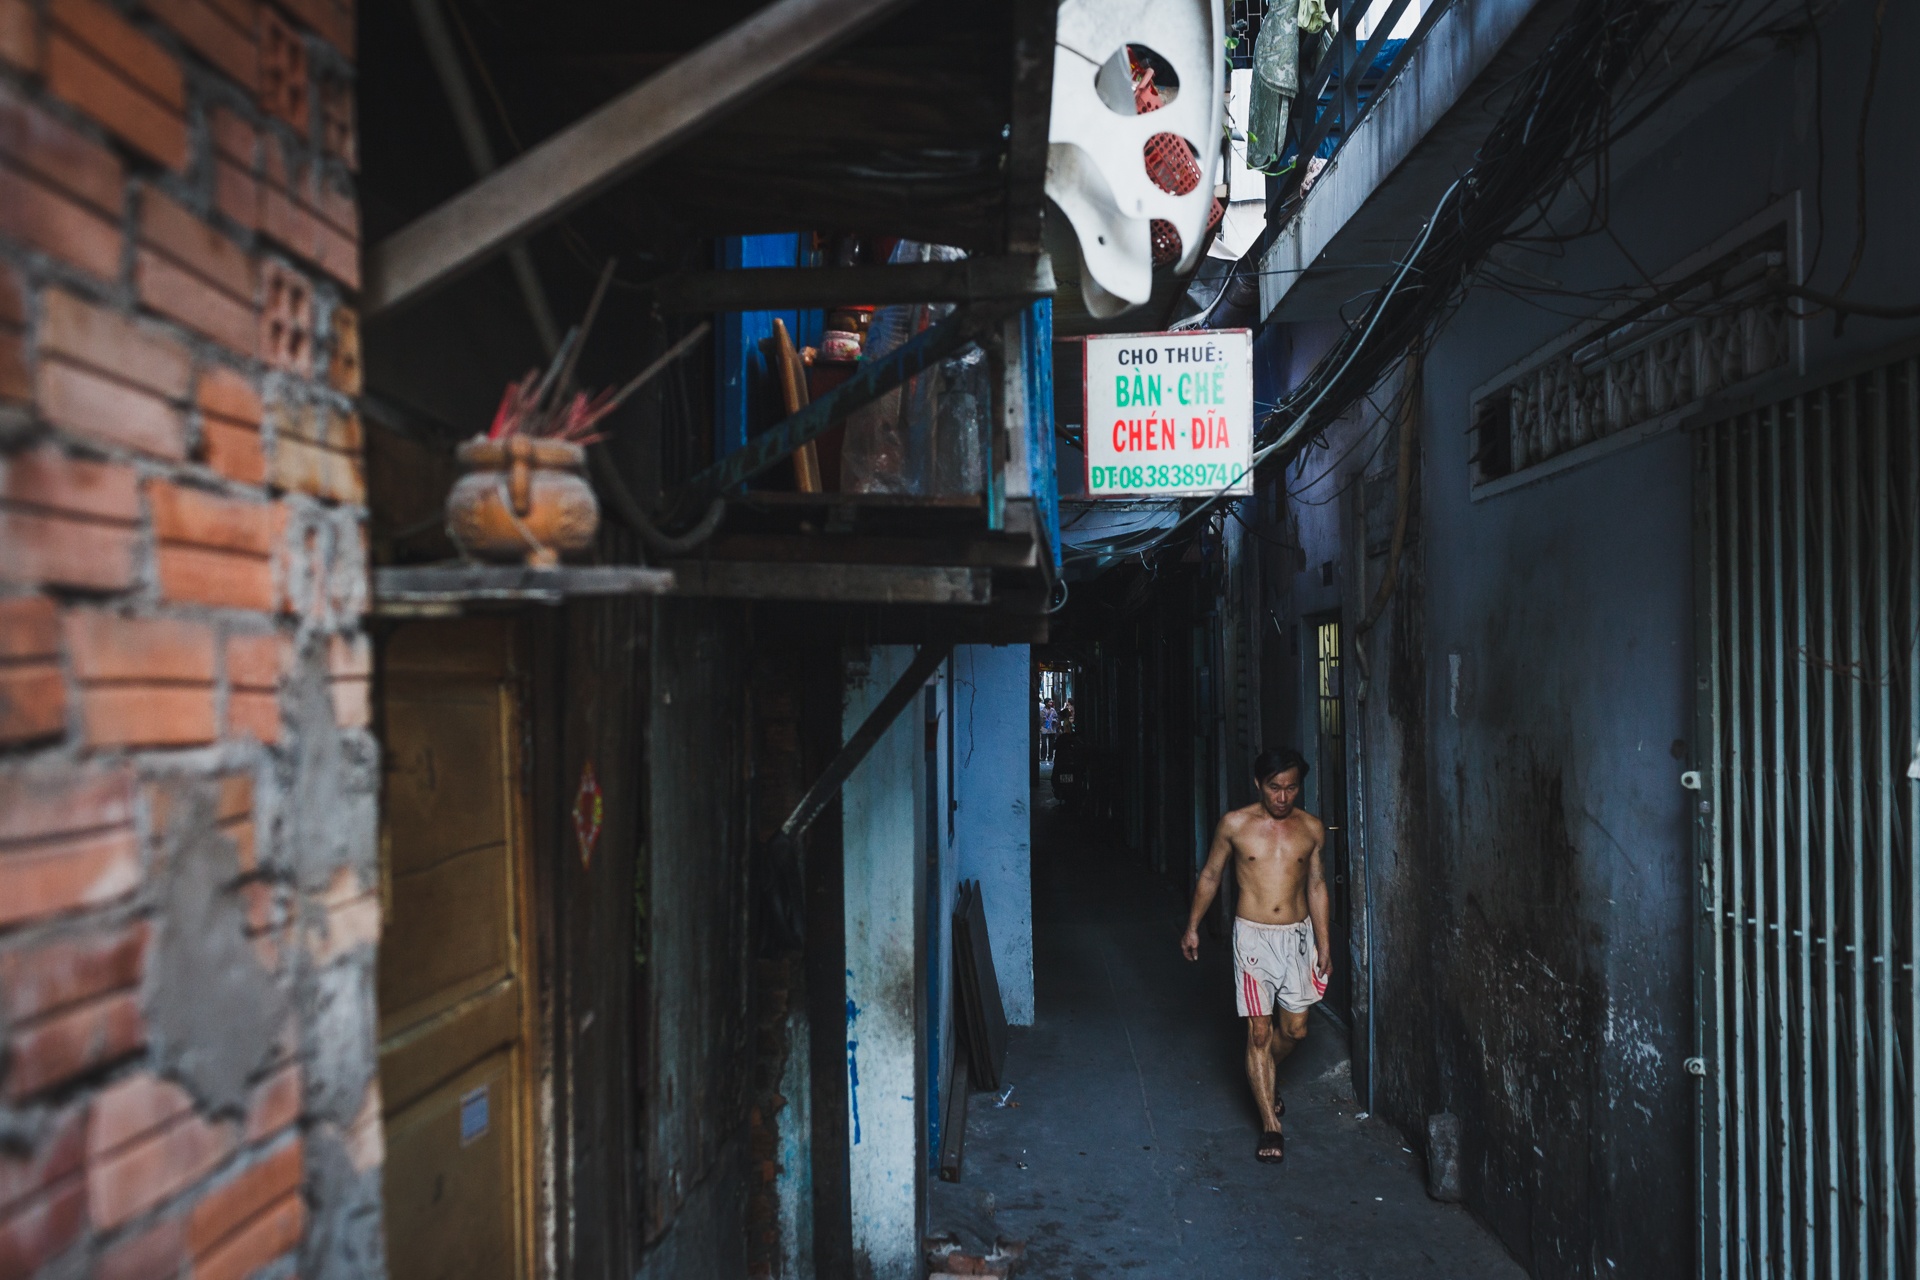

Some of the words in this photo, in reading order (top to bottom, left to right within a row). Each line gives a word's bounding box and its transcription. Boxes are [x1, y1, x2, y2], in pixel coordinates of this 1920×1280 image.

[1118, 348, 1159, 366] CHO
[1165, 341, 1223, 363] THUÊ:
[1115, 367, 1162, 408] BÀN
[1112, 410, 1176, 453] CHÉN
